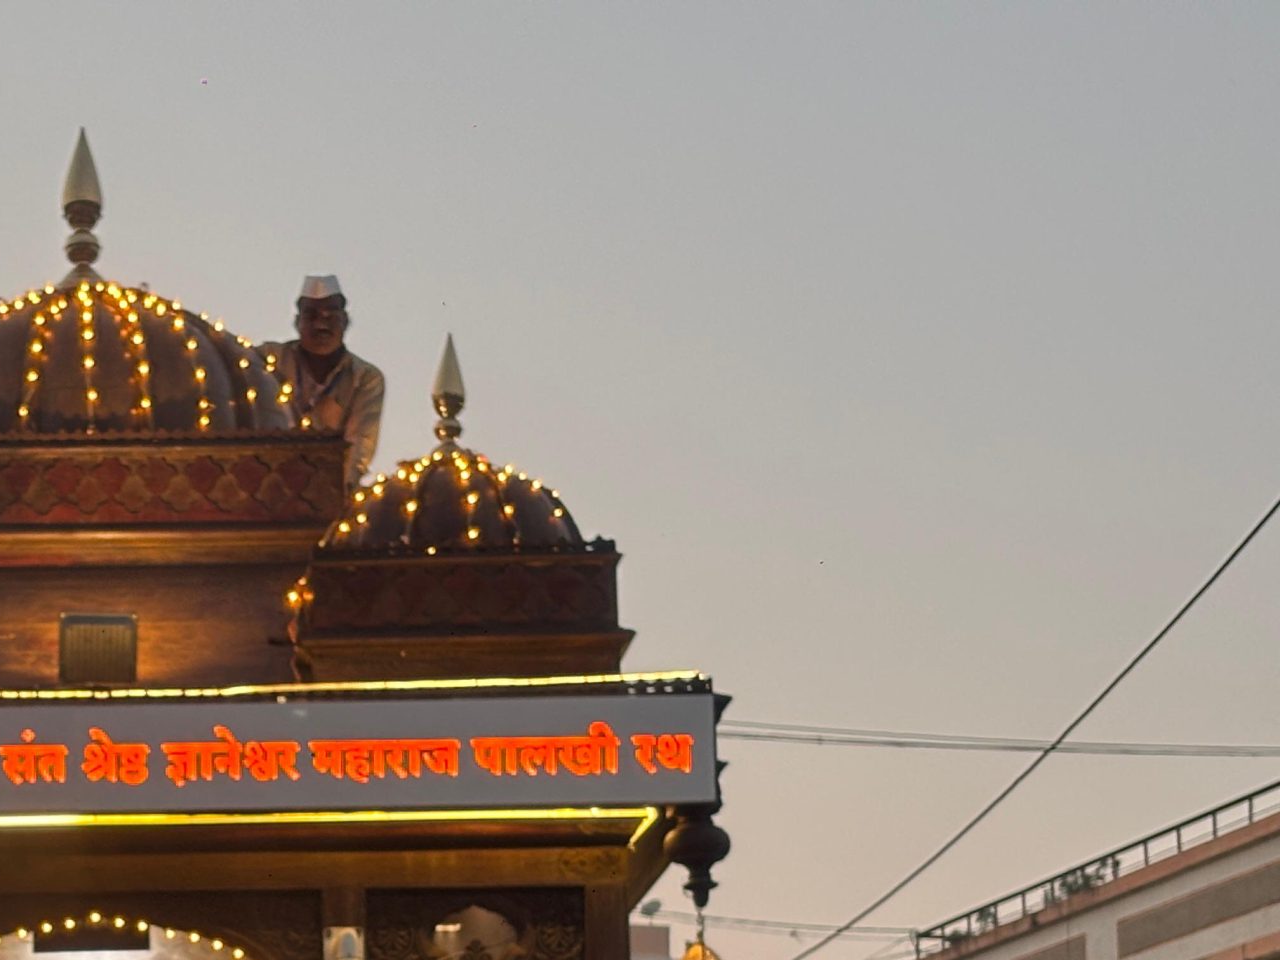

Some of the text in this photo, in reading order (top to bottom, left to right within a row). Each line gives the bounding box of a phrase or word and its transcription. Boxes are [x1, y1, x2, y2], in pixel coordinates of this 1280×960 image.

[80, 727, 151, 786] श्रेष्ठ
[160, 725, 301, 787] ज्ञानेश्वर
[308, 737, 461, 783] महाराज
[469, 721, 621, 776] पालखी
[631, 734, 694, 774] रथ
